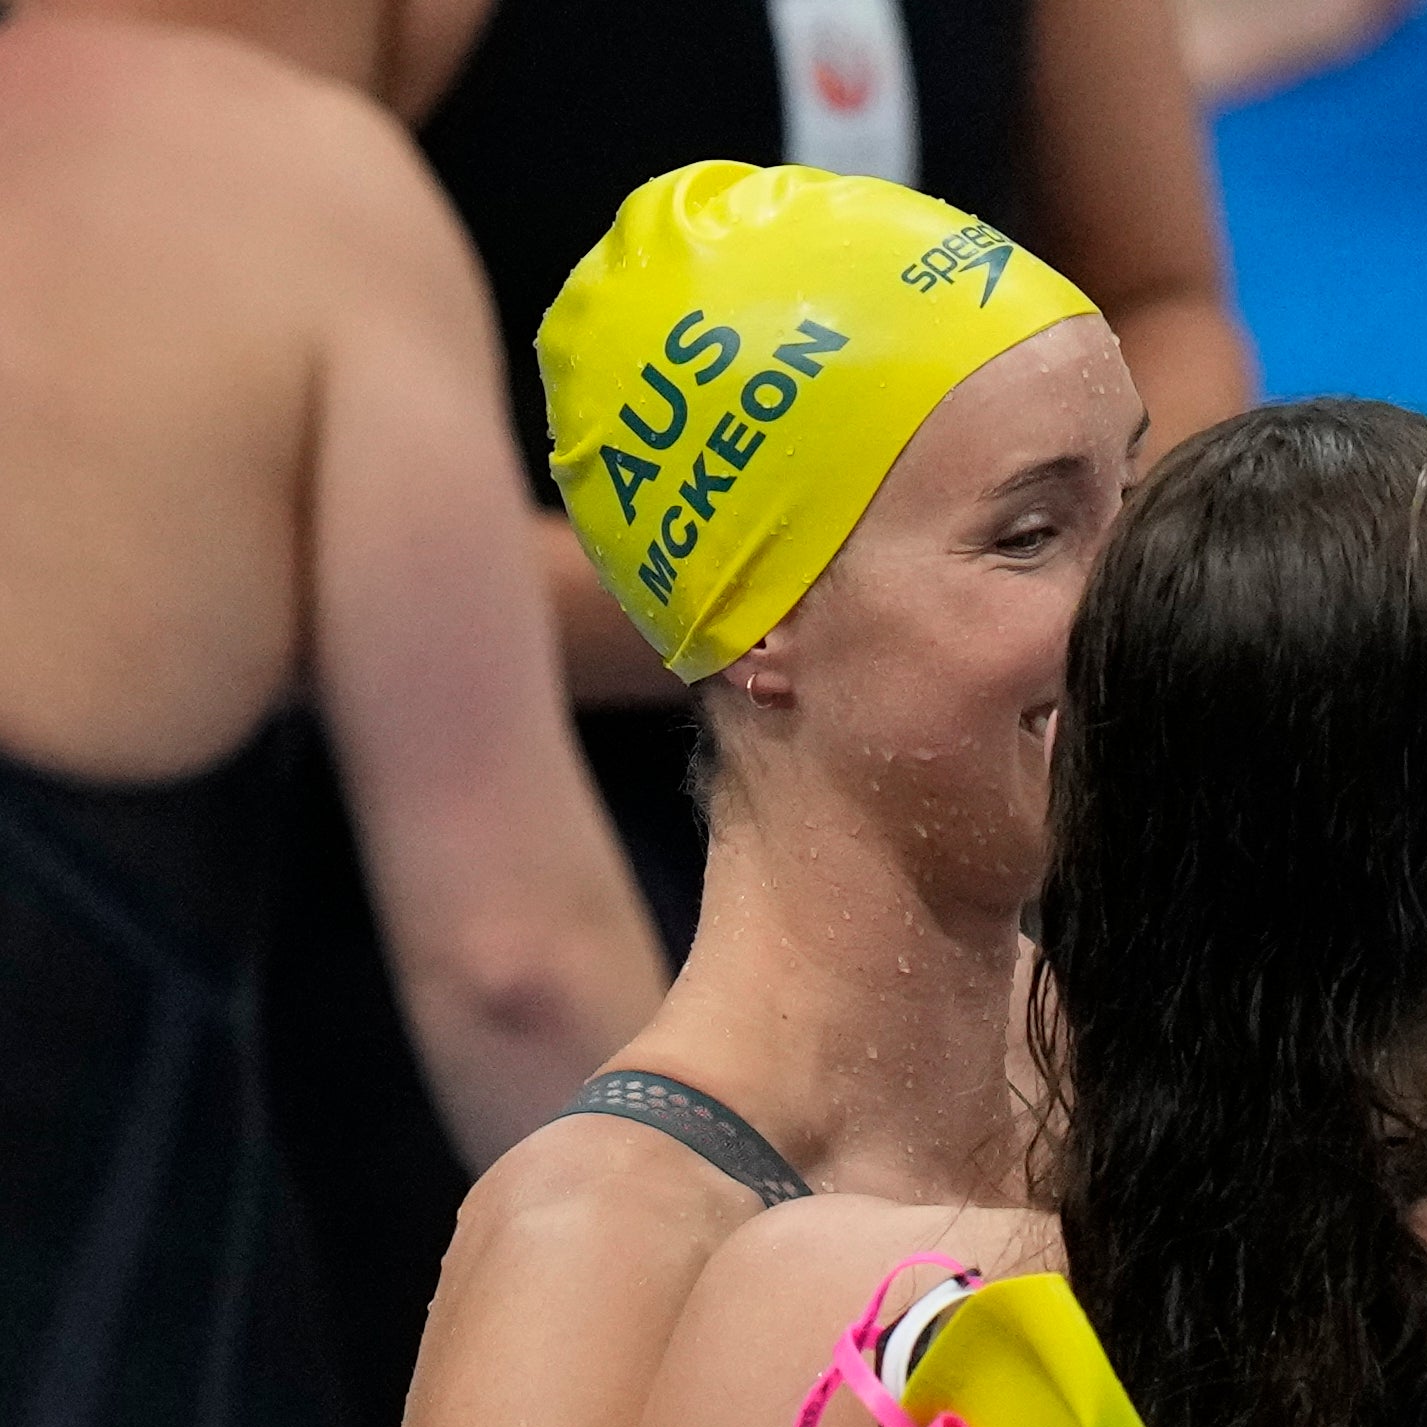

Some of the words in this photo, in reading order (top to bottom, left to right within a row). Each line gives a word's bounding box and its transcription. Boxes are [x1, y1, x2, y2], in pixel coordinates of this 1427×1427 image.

[901, 223, 1008, 294] speed
[600, 309, 741, 526] AUS
[638, 319, 850, 606] MCKEON
